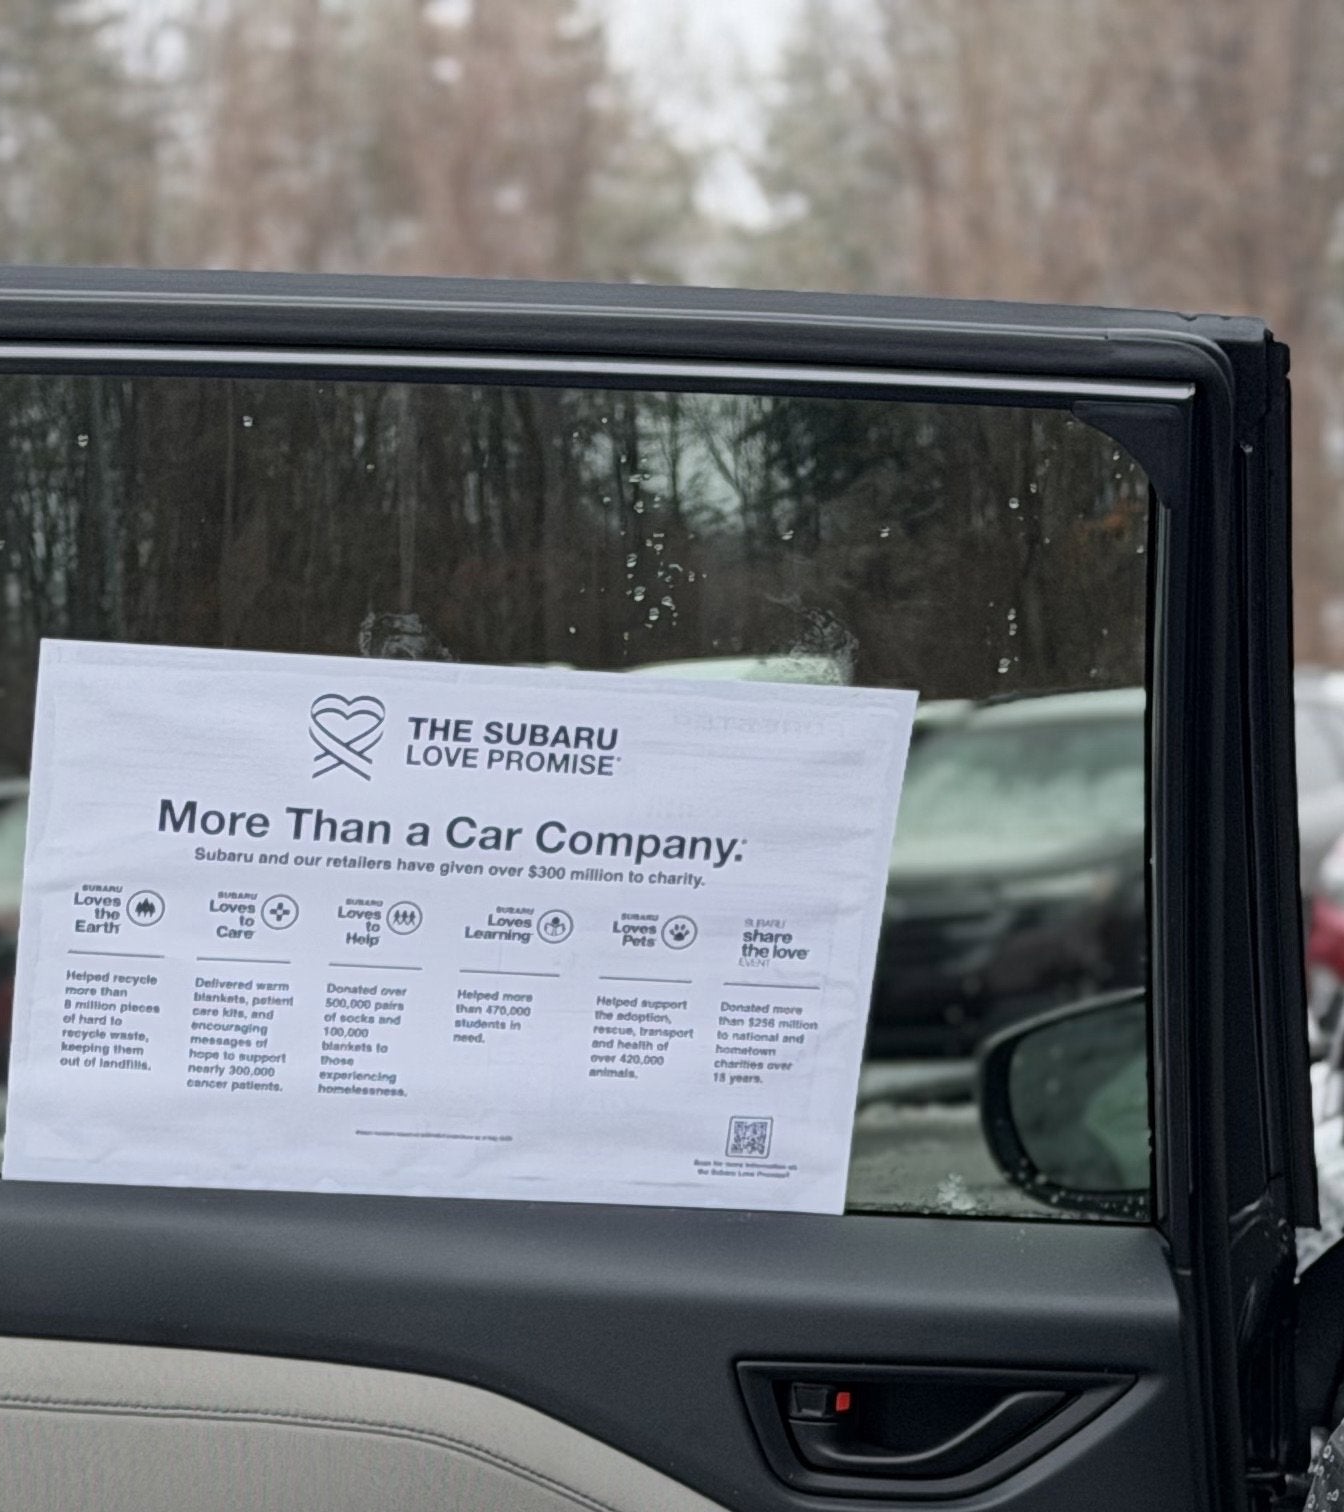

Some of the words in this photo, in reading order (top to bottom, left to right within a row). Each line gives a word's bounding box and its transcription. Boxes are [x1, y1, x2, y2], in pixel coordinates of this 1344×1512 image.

[408, 716, 473, 743] THE
[484, 721, 618, 751] SUBARU
[406, 744, 479, 769] LOVE
[158, 799, 271, 839] More
[285, 806, 392, 845] Than
[405, 821, 431, 847] a
[446, 816, 523, 852] Car
[194, 846, 254, 864] Subaru
[258, 851, 290, 866] and
[293, 855, 322, 867] our
[326, 855, 392, 871] retailers
[396, 857, 435, 873] have
[439, 860, 484, 877] given
[488, 865, 524, 878] over
[528, 864, 566, 880] $300
[570, 867, 624, 882] million
[628, 871, 644, 885] to
[648, 870, 707, 890] charity.
[73, 892, 122, 908] Loves
[209, 899, 256, 914] Loves
[94, 907, 121, 921] the
[337, 905, 383, 921] Loves
[487, 913, 533, 928] Loves
[74, 919, 120, 934] Earth
[239, 915, 256, 928] to
[365, 921, 381, 934] to
[612, 920, 657, 935] Loves
[216, 925, 255, 940] Care
[345, 931, 380, 948] Help
[464, 926, 532, 944] Learning
[742, 928, 793, 944] share
[621, 934, 656, 948] Pets
[741, 943, 770, 959] the
[772, 944, 808, 960] love
[66, 969, 111, 984] Helped
[112, 974, 158, 987] recycle
[194, 977, 254, 991] Delivered
[255, 982, 290, 992] warm
[64, 986, 97, 997] more
[100, 986, 128, 998] than
[326, 982, 378, 996] Donated
[380, 987, 407, 997] over
[457, 989, 500, 1003] Helped
[502, 993, 534, 1003] more
[74, 999, 117, 1012] million
[374, 1000, 405, 1012] pairs
[455, 1003, 483, 1015] than
[596, 995, 639, 1009] Helped
[640, 999, 688, 1011] support
[720, 1001, 770, 1014] Donated
[772, 1005, 803, 1016] more
[62, 1012, 76, 1024] of
[78, 1013, 107, 1026] hard
[110, 1015, 123, 1027] to
[192, 1007, 219, 1017] care
[250, 1009, 275, 1021] and
[323, 1011, 337, 1023] of
[339, 1013, 375, 1025] socks
[378, 1015, 402, 1026] and
[594, 1009, 614, 1021] the
[190, 1021, 268, 1037] encouraging
[454, 1018, 507, 1030] students
[509, 1019, 522, 1031] in
[718, 1015, 745, 1027] than
[778, 1019, 819, 1031] million
[62, 1028, 107, 1041] recycle
[324, 1026, 369, 1039] 100,000
[639, 1026, 694, 1040] transport
[716, 1029, 729, 1041] to
[732, 1031, 780, 1043] national
[782, 1033, 805, 1045] and
[60, 1041, 110, 1057] keeping
[113, 1044, 144, 1056] them
[190, 1035, 252, 1049] messages
[255, 1035, 268, 1049] of
[321, 1040, 373, 1053] blankets
[375, 1042, 389, 1054] to
[591, 1038, 615, 1049] and
[616, 1039, 654, 1051] health
[656, 1040, 670, 1052] of
[188, 1048, 220, 1062] hope
[222, 1050, 236, 1062] to
[238, 1052, 287, 1064] support
[715, 1044, 777, 1057] hometown
[59, 1056, 81, 1067] out
[83, 1056, 97, 1068] of
[320, 1055, 355, 1067] those
[590, 1054, 617, 1064] over
[713, 1058, 764, 1070] charities
[766, 1062, 793, 1071] over
[187, 1064, 226, 1077] nearly
[319, 1070, 397, 1085] experiencing
[186, 1078, 228, 1089] cancer
